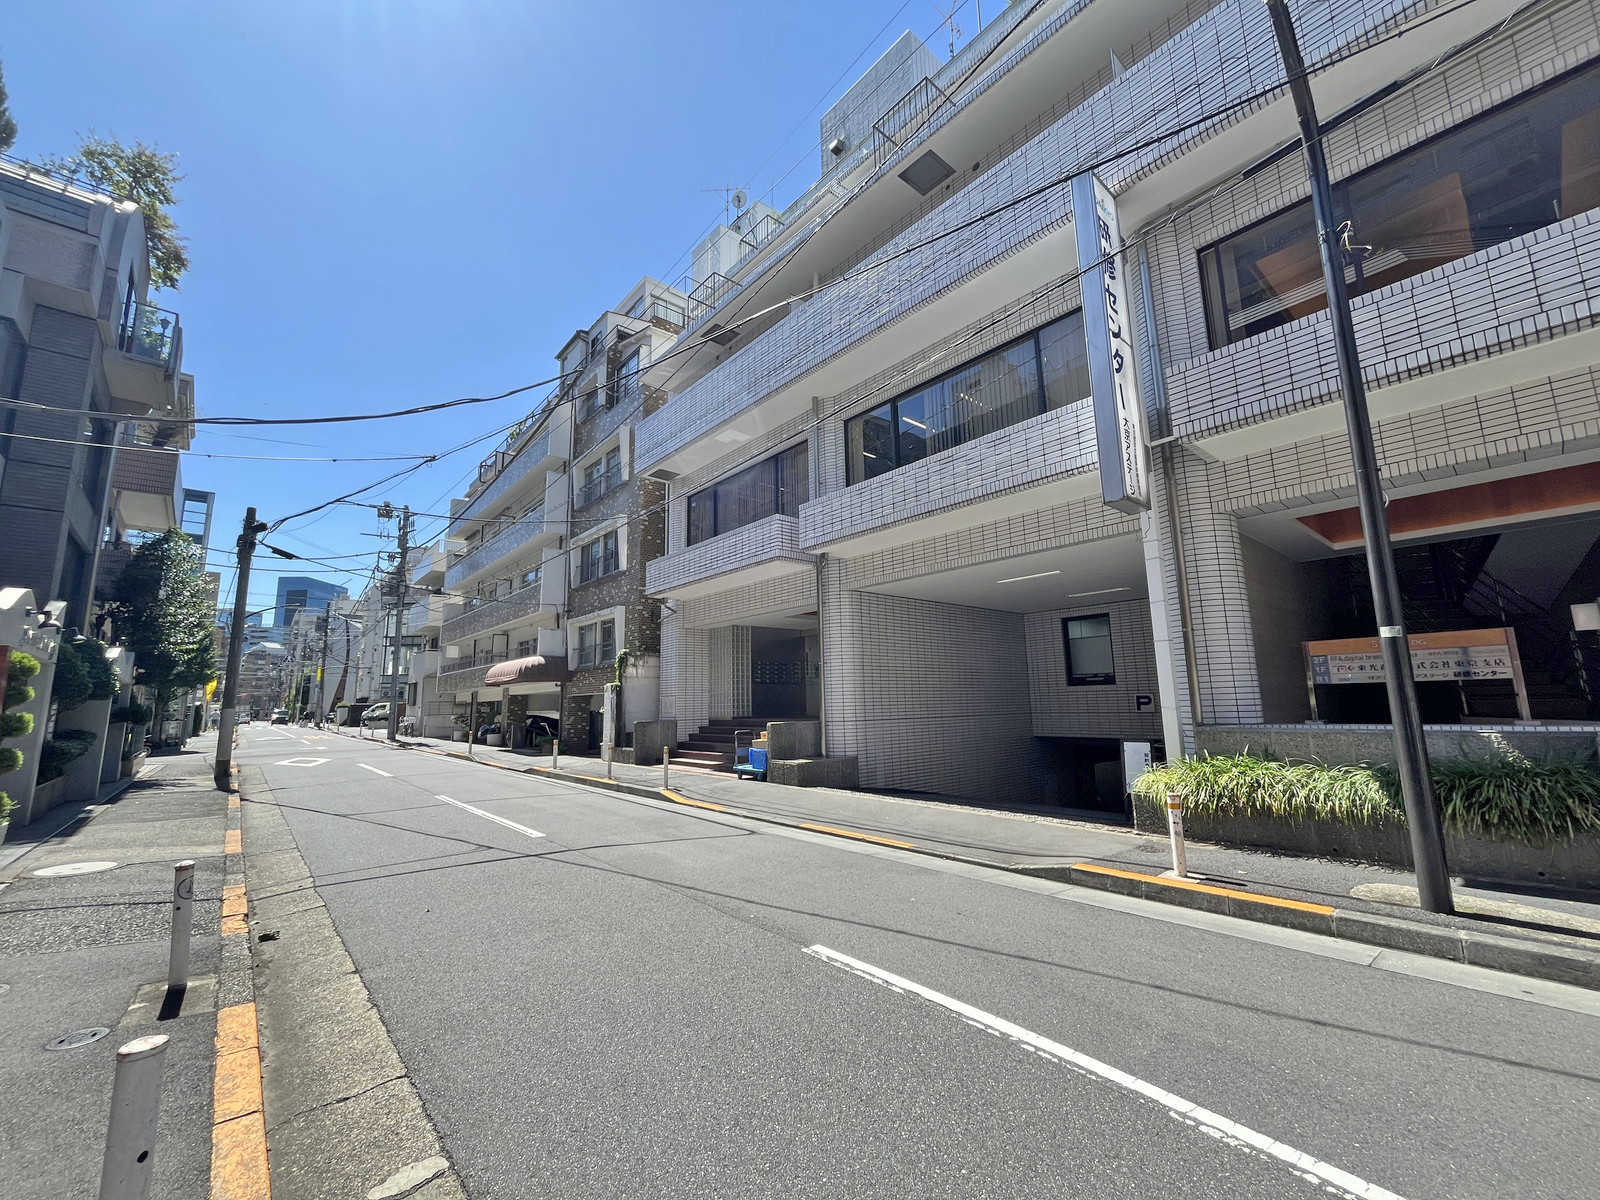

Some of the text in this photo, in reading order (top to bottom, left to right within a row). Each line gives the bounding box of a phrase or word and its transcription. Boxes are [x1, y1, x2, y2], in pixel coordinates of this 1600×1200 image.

[1098, 214, 1125, 410] 研修センター
[1122, 417, 1136, 496] 大京アステージ
[1313, 656, 1326, 664] 2F
[1136, 695, 1152, 711] P
